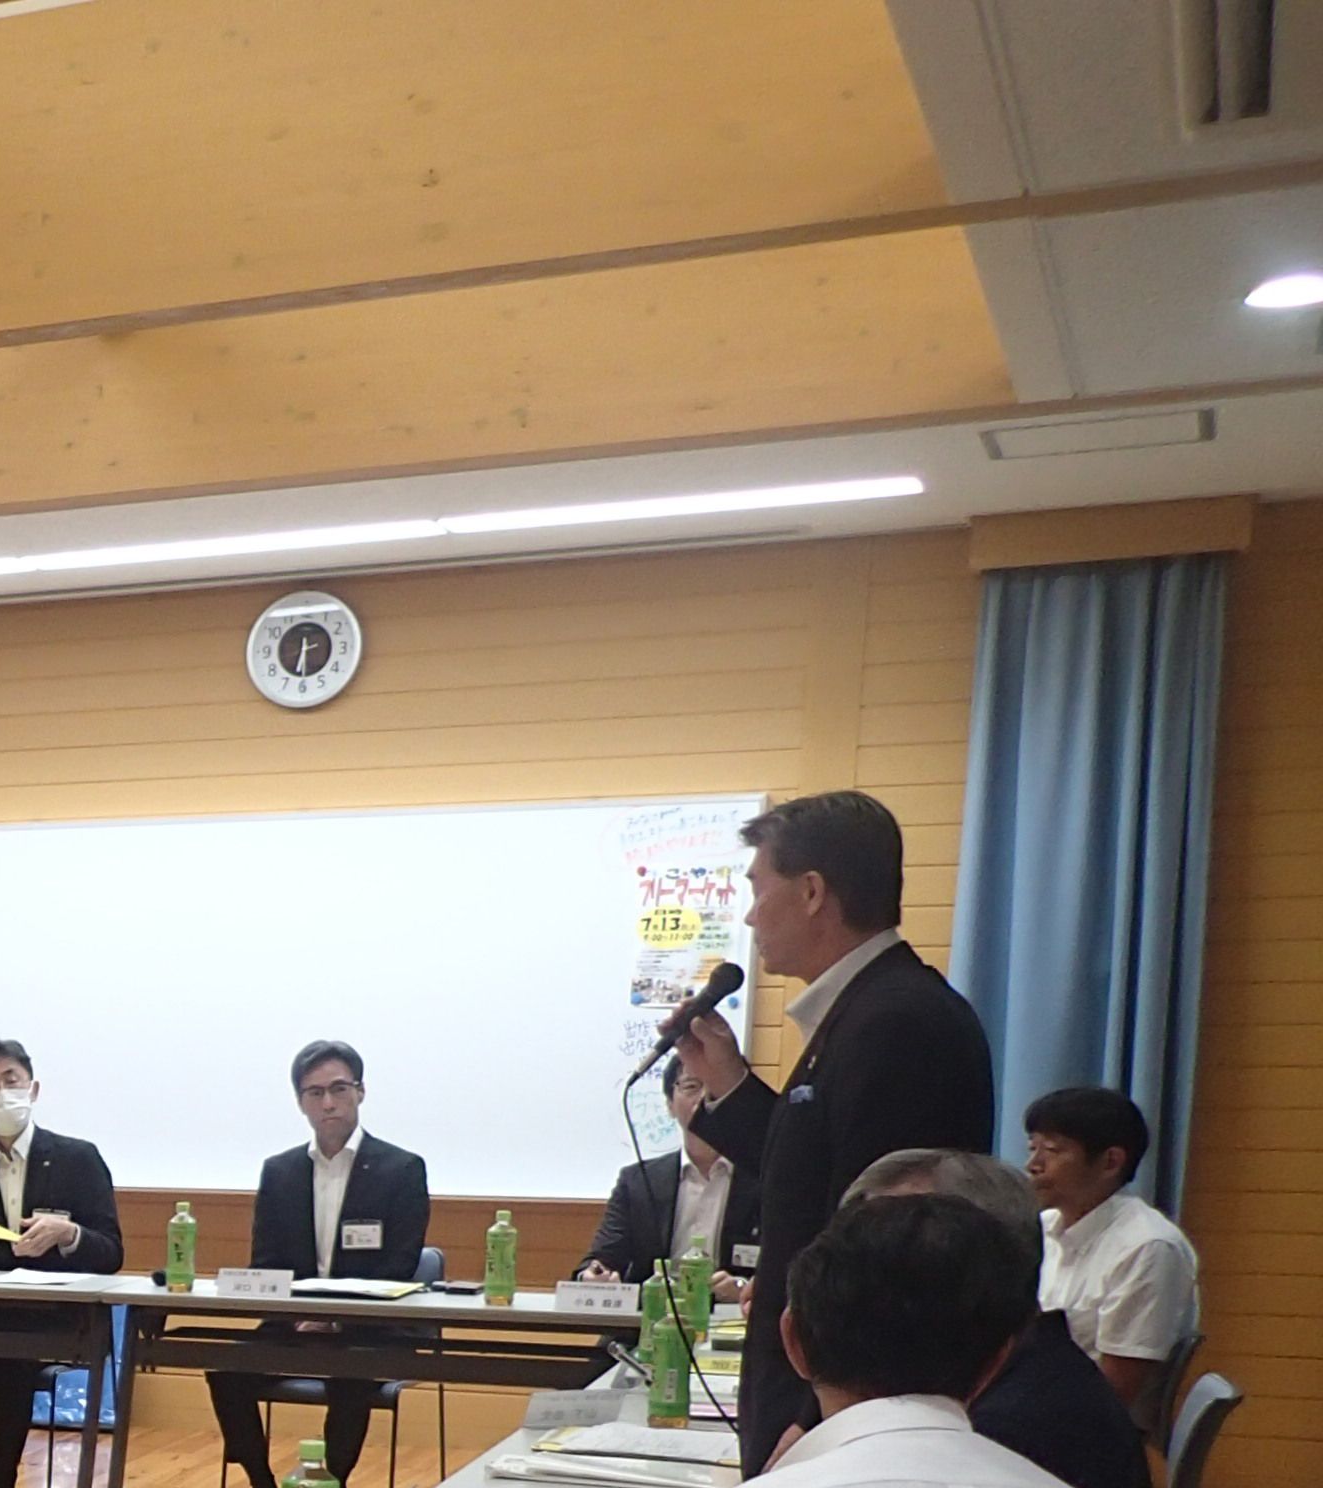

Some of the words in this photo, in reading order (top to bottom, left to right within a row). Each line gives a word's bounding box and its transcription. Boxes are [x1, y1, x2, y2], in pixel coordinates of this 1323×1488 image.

[267, 626, 281, 639] 10
[333, 622, 343, 635] 2
[261, 646, 271, 659] 9
[339, 641, 348, 655] 3
[268, 664, 277, 677] 8
[330, 661, 340, 673] 4
[281, 677, 290, 690] 7
[298, 679, 307, 693] 6
[317, 675, 326, 688] 5
